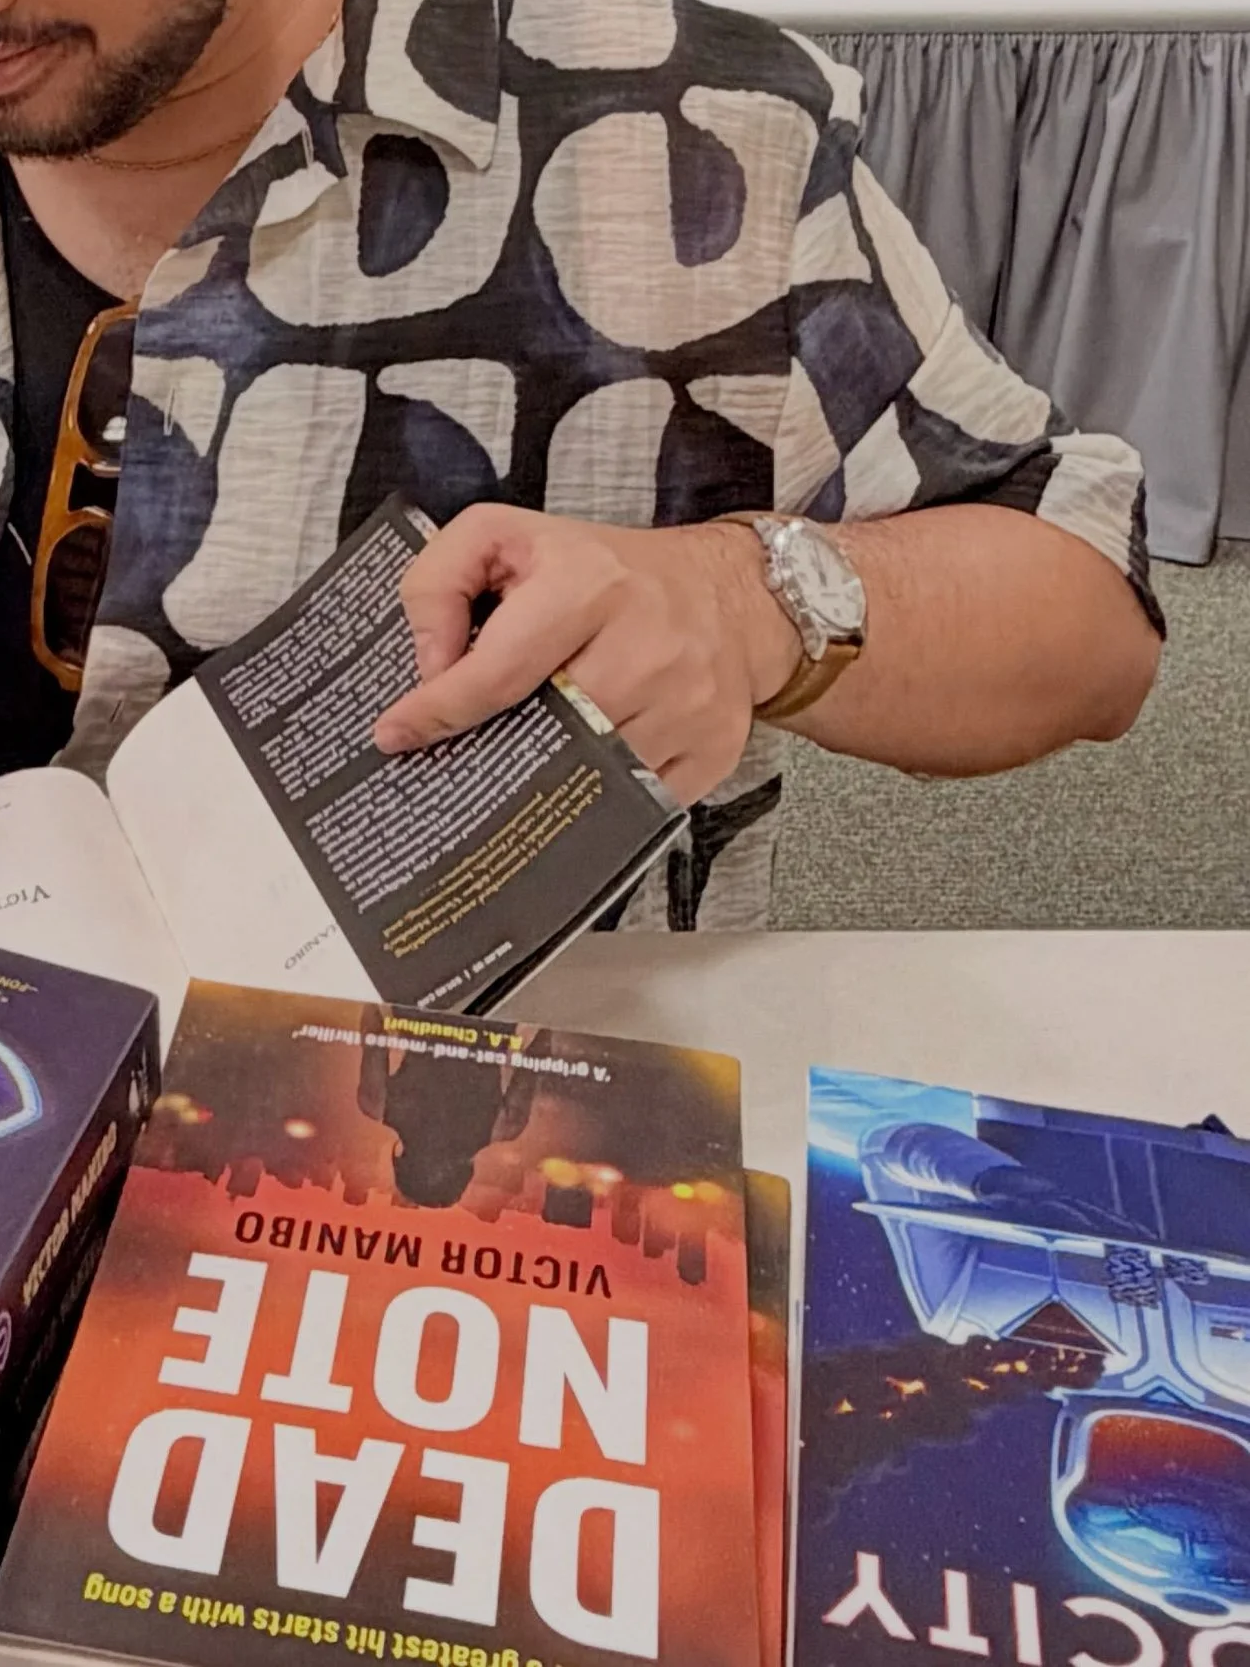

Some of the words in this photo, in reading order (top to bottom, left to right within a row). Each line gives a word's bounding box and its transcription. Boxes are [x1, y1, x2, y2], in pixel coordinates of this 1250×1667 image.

[383, 1016, 479, 1043] Chaudhuri
[365, 1033, 507, 1065] cat-and-mouse
[511, 1052, 590, 1077] gripping
[234, 1211, 422, 1268] MANIBO
[439, 1239, 612, 1298] VICTOR
[158, 1252, 648, 1466] NOTE
[107, 1408, 660, 1660] DEAD
[83, 1572, 152, 1608] song
[158, 1591, 175, 1613] a
[182, 1596, 245, 1628] with
[252, 1607, 340, 1645] starts
[347, 1625, 385, 1656] hit
